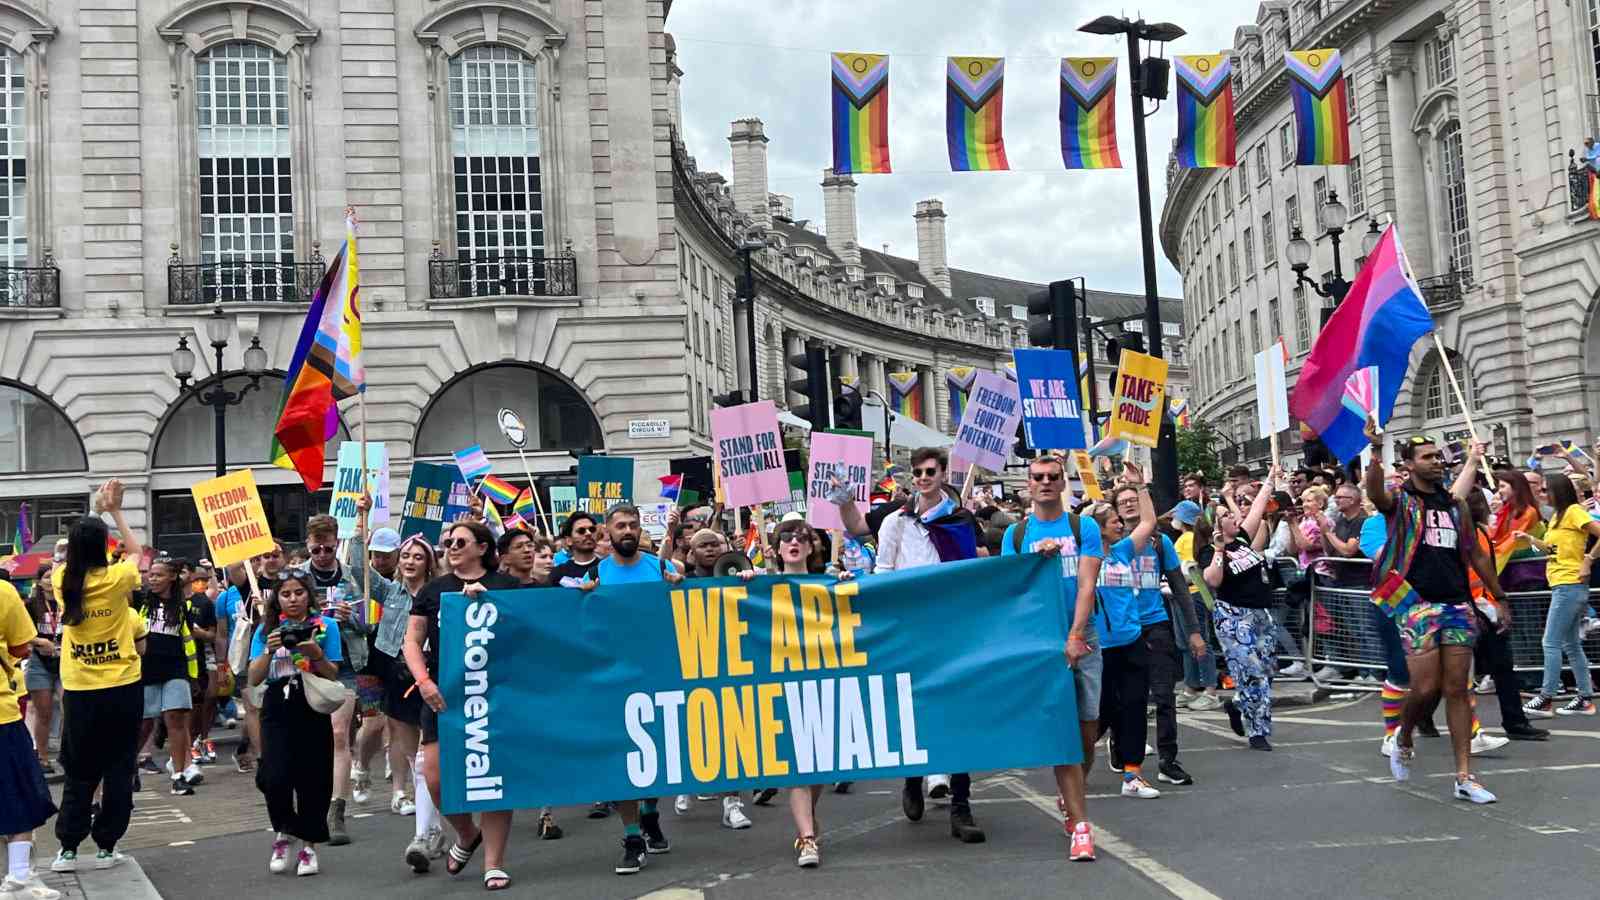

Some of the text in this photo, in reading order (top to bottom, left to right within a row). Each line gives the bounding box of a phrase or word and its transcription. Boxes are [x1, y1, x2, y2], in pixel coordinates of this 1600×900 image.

[976, 386, 1017, 416] FREEDOM.
[1028, 379, 1067, 398] WE ARE
[1121, 374, 1154, 403] TAKE
[974, 408, 1006, 434] EQUITY.
[1023, 399, 1080, 418] STONEWALL
[1118, 402, 1150, 427] PRIDE
[720, 432, 776, 458] STAND FOR
[961, 424, 1006, 457] POTENTIAL.
[721, 450, 782, 478] STONEWALL
[848, 465, 866, 483] FOR
[203, 486, 252, 513] FREEDOM.
[414, 487, 428, 502] WE
[588, 481, 622, 498] WE ARE
[214, 505, 252, 530] EQUITY.
[334, 497, 358, 518] PRID
[210, 522, 267, 551] POTENTIAL.
[670, 583, 867, 680] WE ARE
[464, 602, 503, 801] Stonewall
[625, 672, 928, 788] STONEWALL
